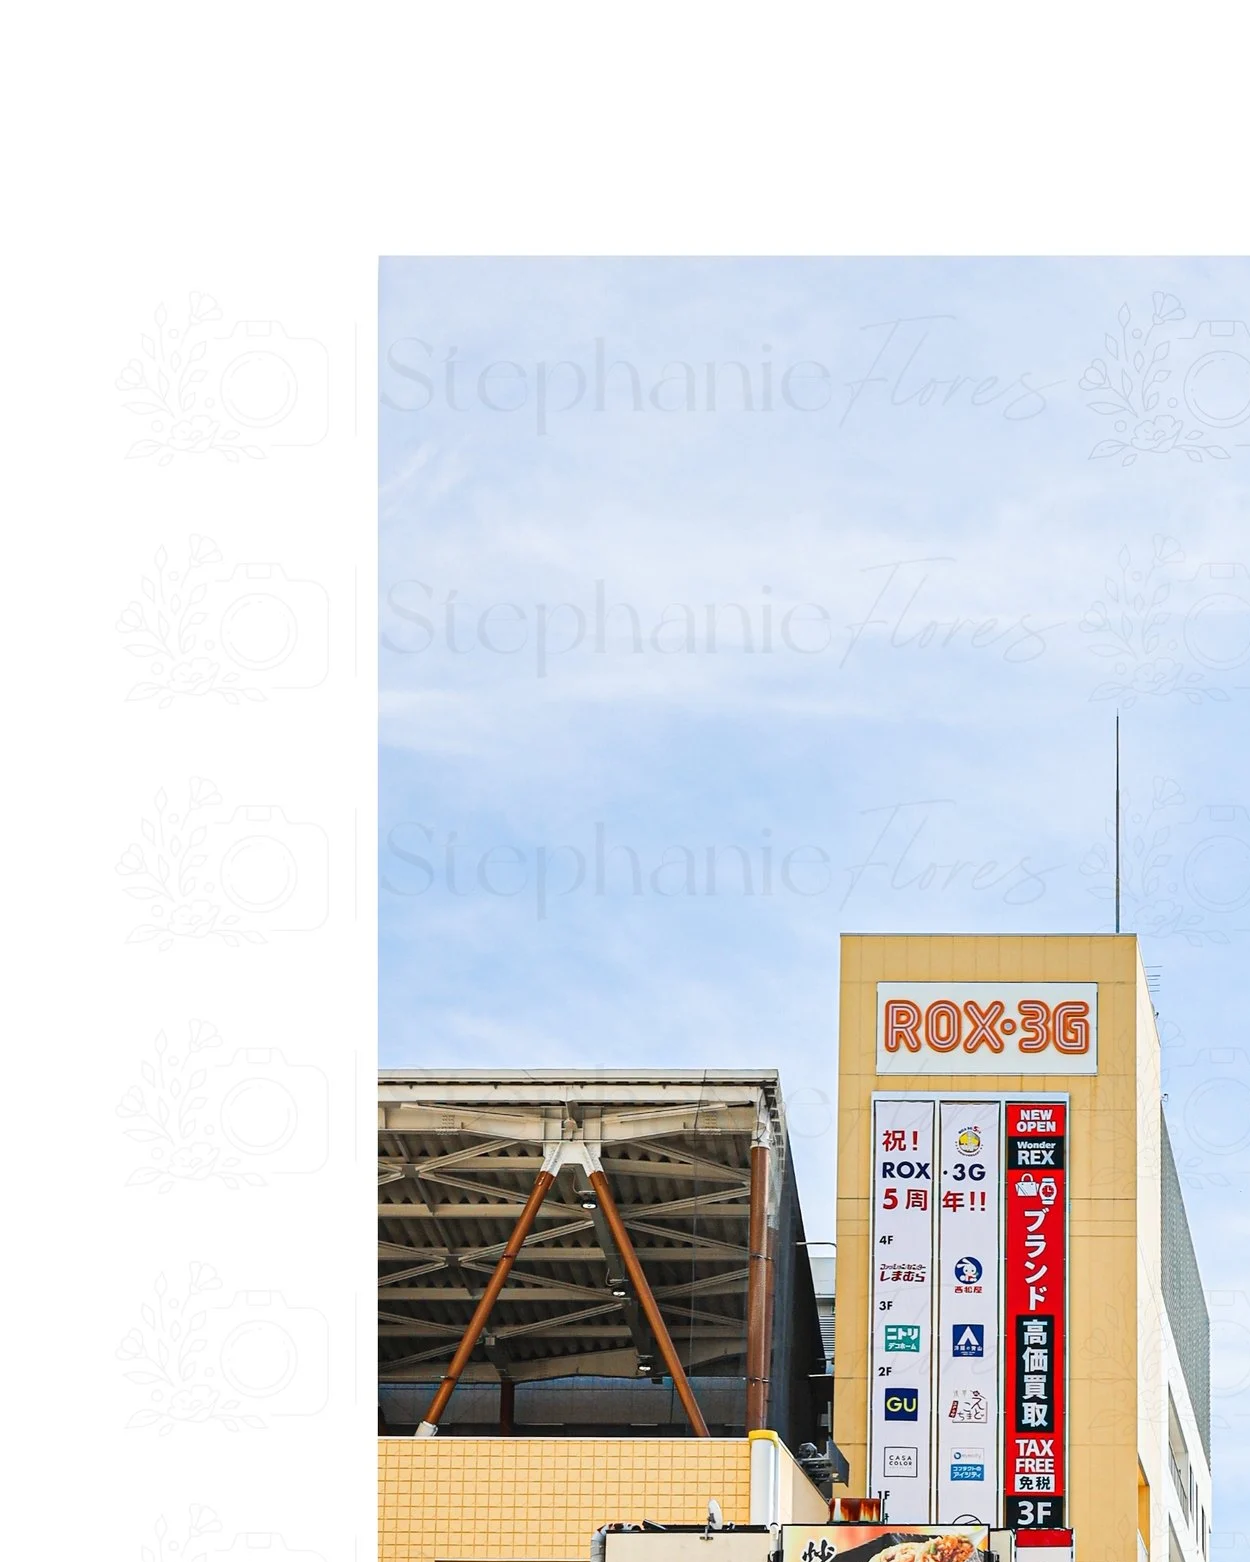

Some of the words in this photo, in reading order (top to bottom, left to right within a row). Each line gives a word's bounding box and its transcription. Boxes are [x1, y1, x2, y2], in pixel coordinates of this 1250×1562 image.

[1020, 1109, 1052, 1120] NEW
[1016, 1121, 1056, 1132] OPEN
[1017, 1141, 1056, 1149] Wonder
[1017, 1150, 1055, 1165] REX
[879, 1235, 894, 1245] 4F
[1024, 1208, 1049, 1311] ブランド
[880, 1271, 926, 1283] しまむら
[954, 1286, 983, 1294] 西松屋
[879, 1301, 893, 1310] 3F
[886, 1328, 919, 1341] ニトリ
[878, 1367, 892, 1376] 2F
[1022, 1319, 1049, 1427] 高価買取
[886, 1397, 917, 1412] GU
[1015, 1439, 1054, 1456] TAX
[1015, 1459, 1054, 1473] FREE
[1019, 1476, 1051, 1490] 免税
[1017, 1501, 1052, 1526] 3F
